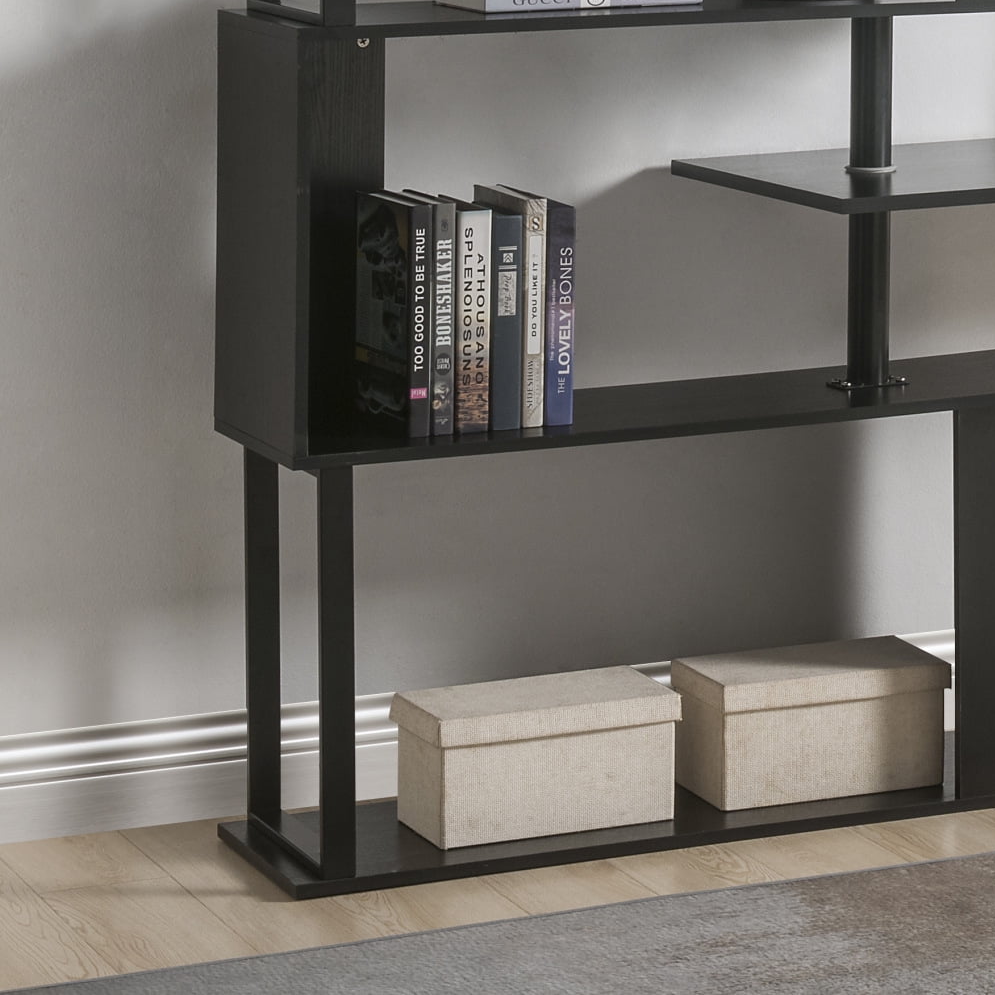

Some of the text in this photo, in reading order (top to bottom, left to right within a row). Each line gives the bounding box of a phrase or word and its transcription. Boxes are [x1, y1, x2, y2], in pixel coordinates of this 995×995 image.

[414, 228, 426, 372] TOO GOOD TO BE TRUE
[436, 238, 452, 347] BONESHAKER
[532, 262, 538, 271] IT
[558, 246, 573, 394] THE LOVELY BONES
[532, 322, 537, 337] DO
